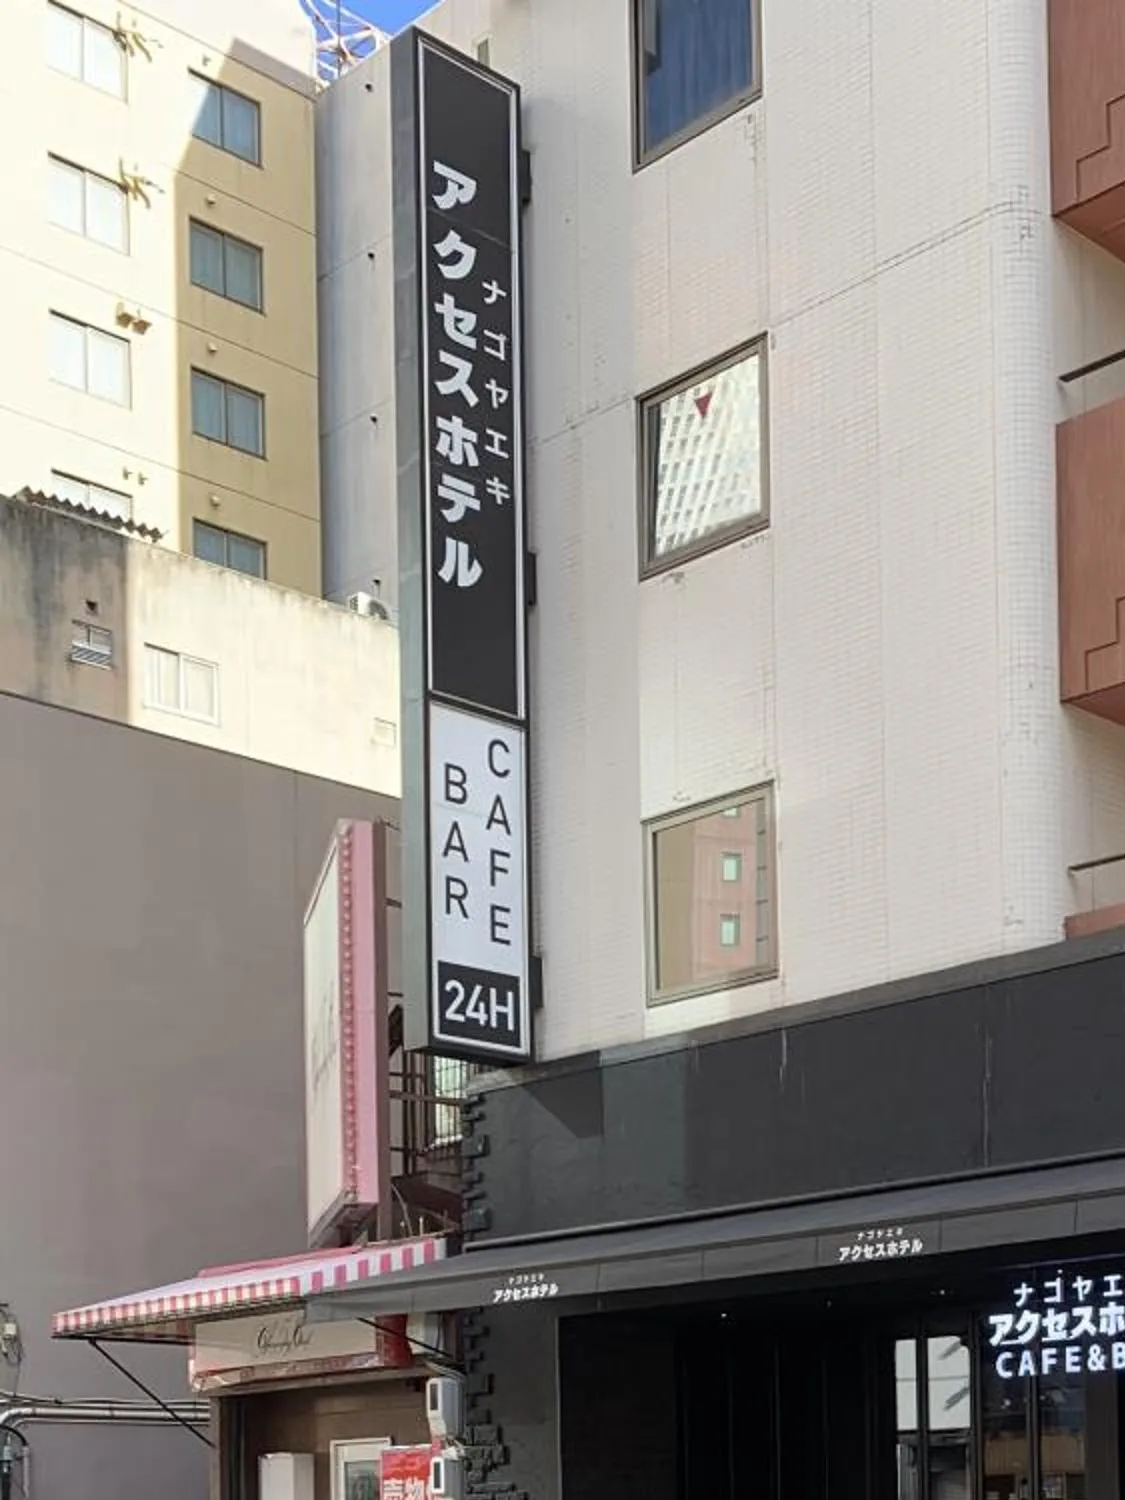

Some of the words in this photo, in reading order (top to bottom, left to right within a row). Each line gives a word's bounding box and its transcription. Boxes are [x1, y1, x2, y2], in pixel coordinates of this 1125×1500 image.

[433, 160, 482, 587] アクセスホテル
[482, 279, 510, 504] ナゴヤエキ
[442, 762, 469, 919] BAR
[486, 738, 511, 946] CAFE
[444, 979, 515, 1032] 24H
[839, 1238, 923, 1261] アクセスホテル
